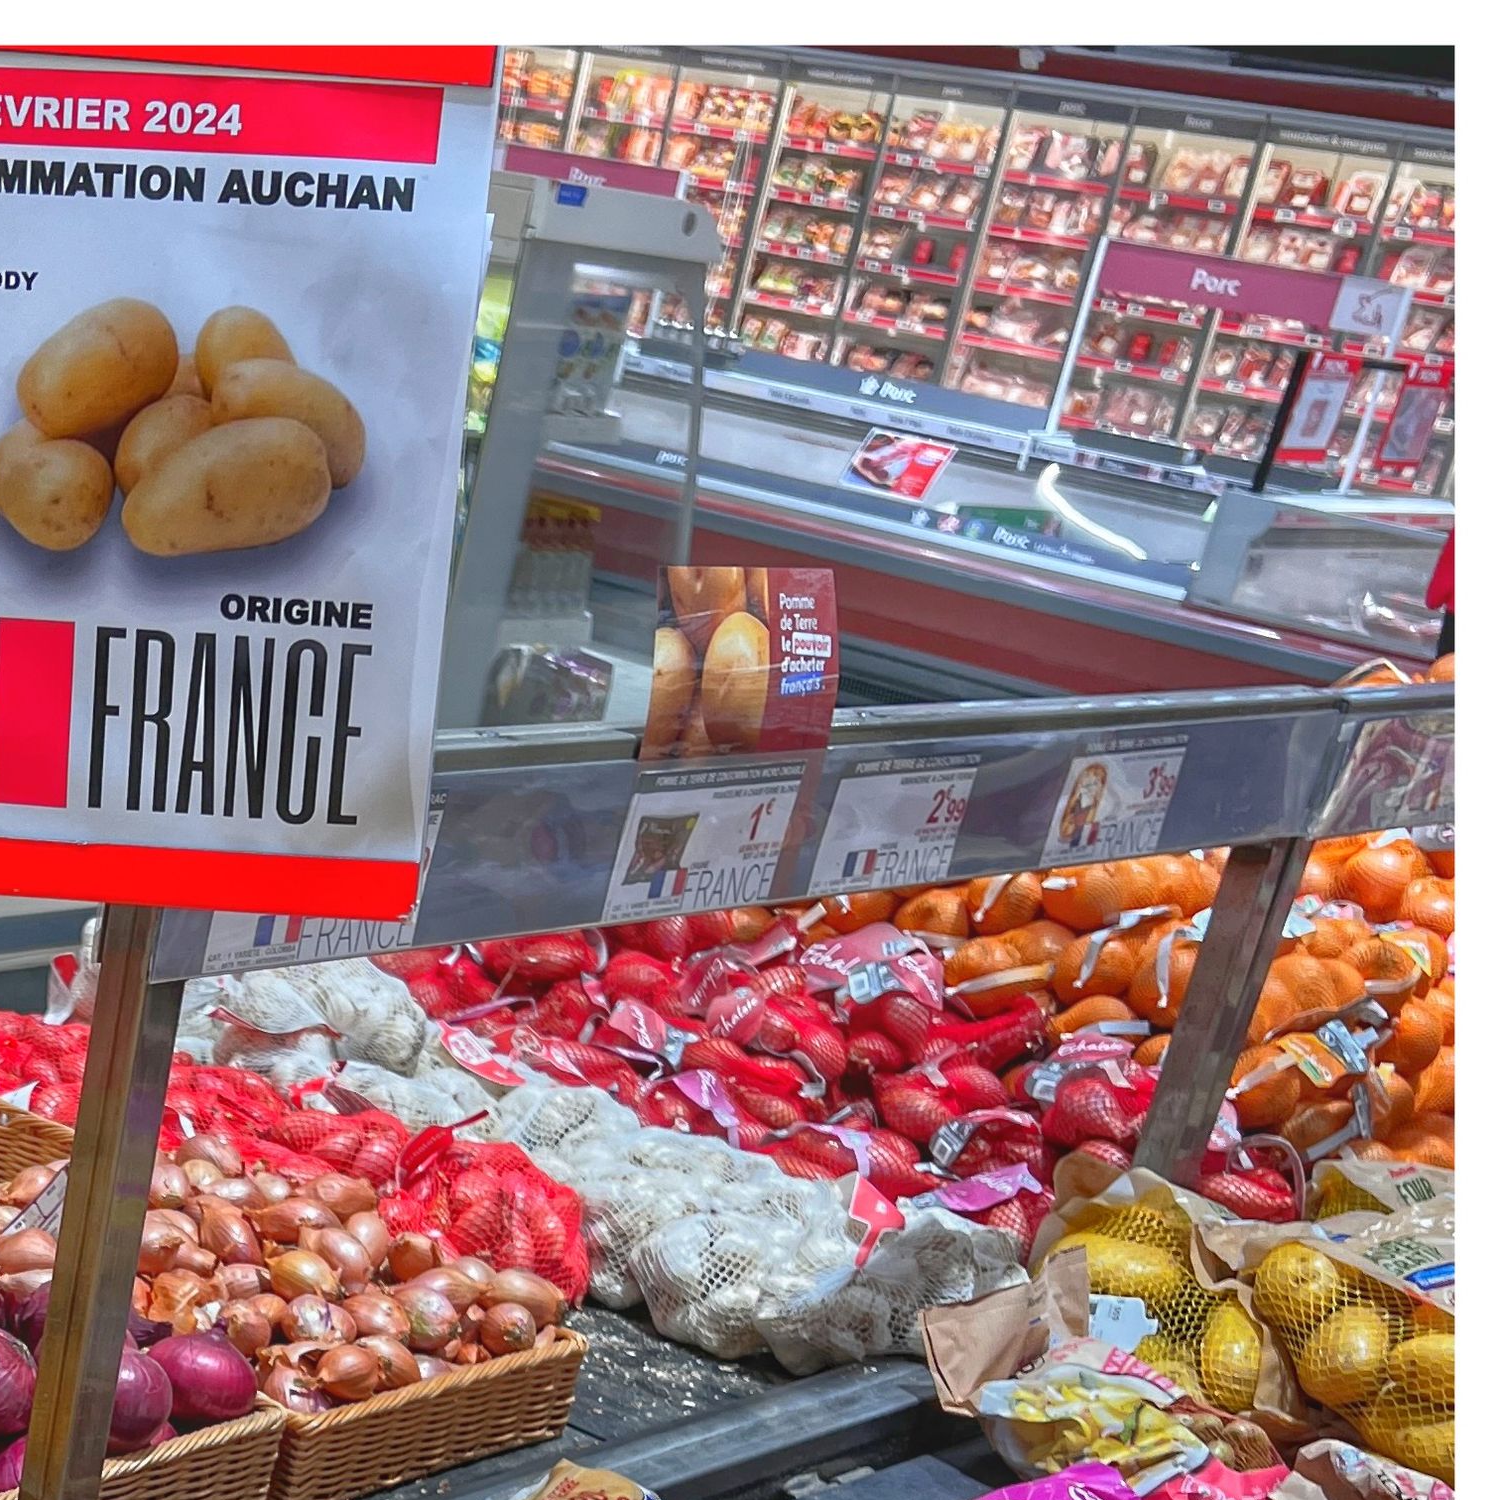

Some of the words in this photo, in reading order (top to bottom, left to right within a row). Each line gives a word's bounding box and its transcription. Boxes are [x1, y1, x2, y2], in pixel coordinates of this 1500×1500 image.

[143, 100, 243, 136] 2024
[217, 168, 415, 212] AUCHAN
[1191, 267, 1242, 297] Porc
[220, 593, 373, 630] ORIGINE
[779, 593, 815, 610] Pomme
[780, 614, 792, 630] de
[793, 613, 818, 631] Terre
[781, 636, 791, 652] le
[781, 656, 825, 673] d'acheter
[87, 626, 373, 826] FRANCE
[869, 845, 954, 888] FRANCE
[680, 862, 776, 910] FRANCE
